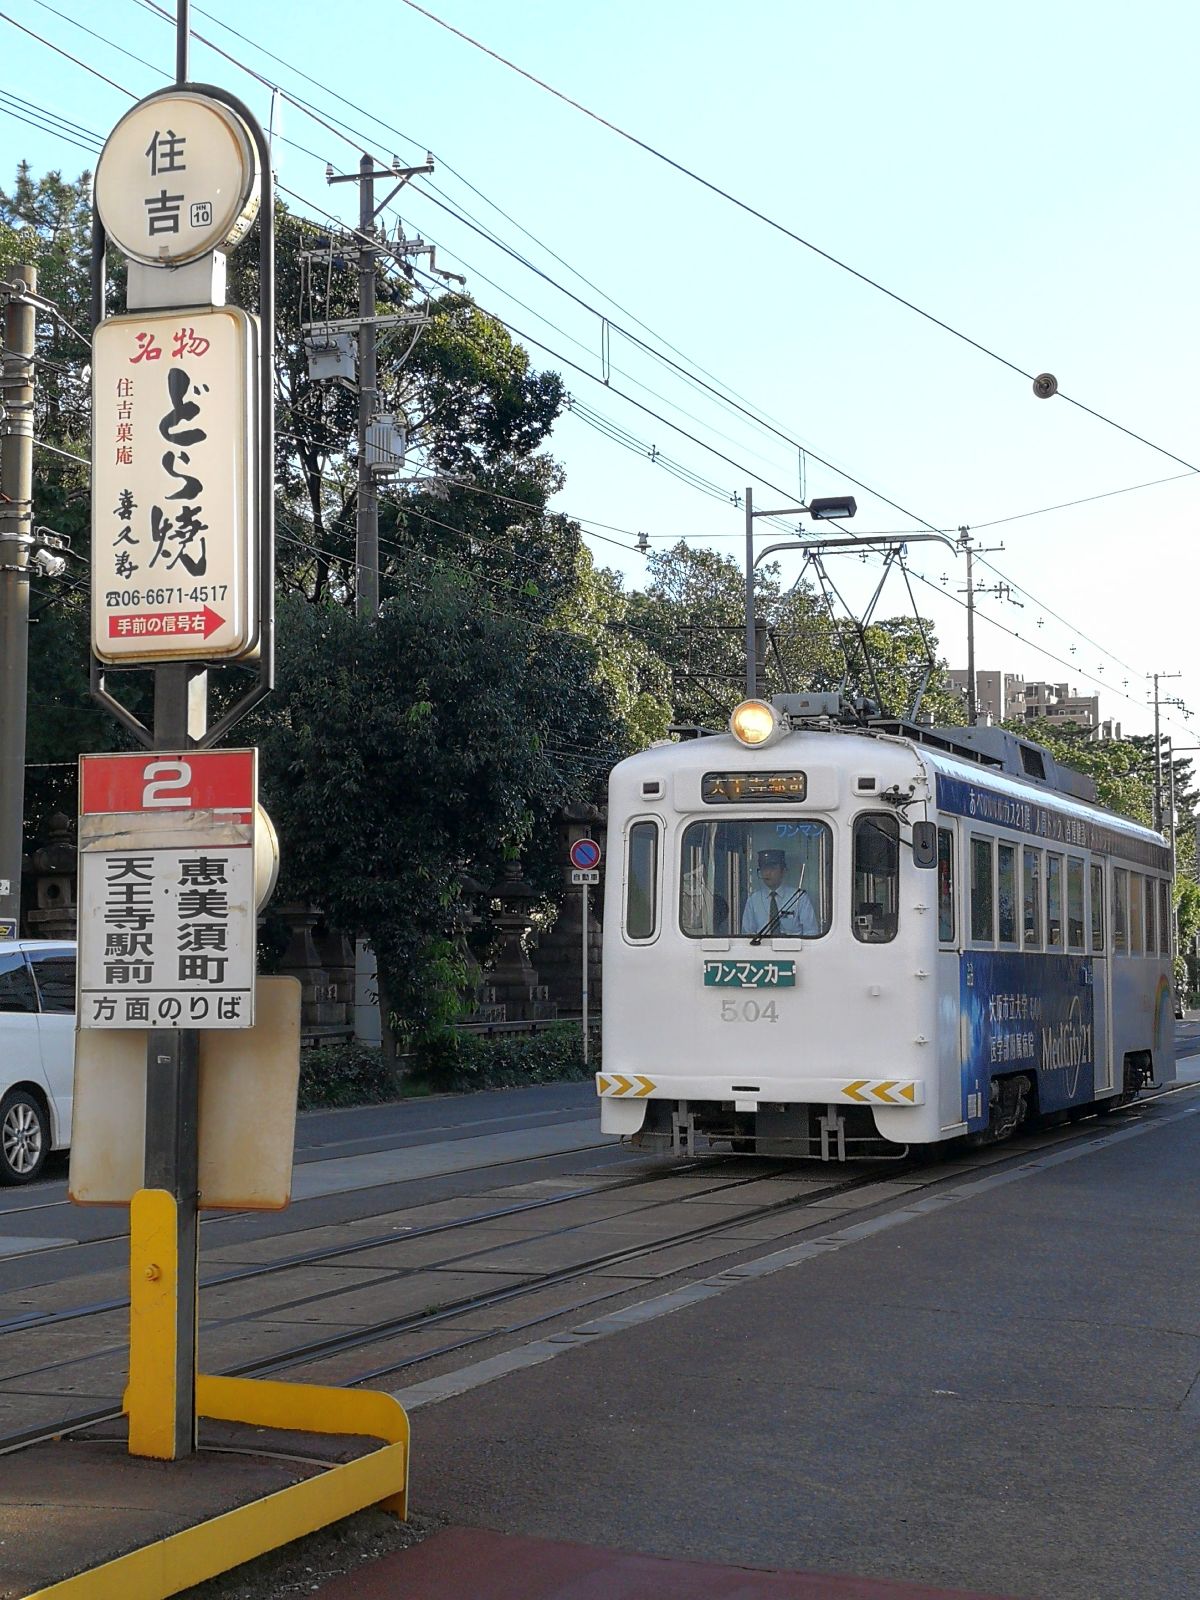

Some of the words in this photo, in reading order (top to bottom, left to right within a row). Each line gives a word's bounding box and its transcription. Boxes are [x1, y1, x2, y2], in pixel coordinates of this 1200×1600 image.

[145, 129, 187, 236] 住吉
[193, 211, 210, 223] 10
[129, 328, 210, 364] 名物
[115, 377, 134, 466] 住吉菓庵
[149, 367, 208, 577] どら焼
[121, 584, 228, 606] 06-6671-4517
[117, 614, 206, 634] 手前の信号右
[142, 760, 192, 808] 2
[776, 824, 824, 838] ワンマン
[104, 857, 155, 984] 天王寺駅前
[177, 856, 229, 984] 恵美須町
[707, 963, 793, 984] ワンマンカー
[93, 996, 242, 1021] 方面のりば
[720, 999, 779, 1023] 504
[1043, 1022, 1091, 1071] MedCity21
